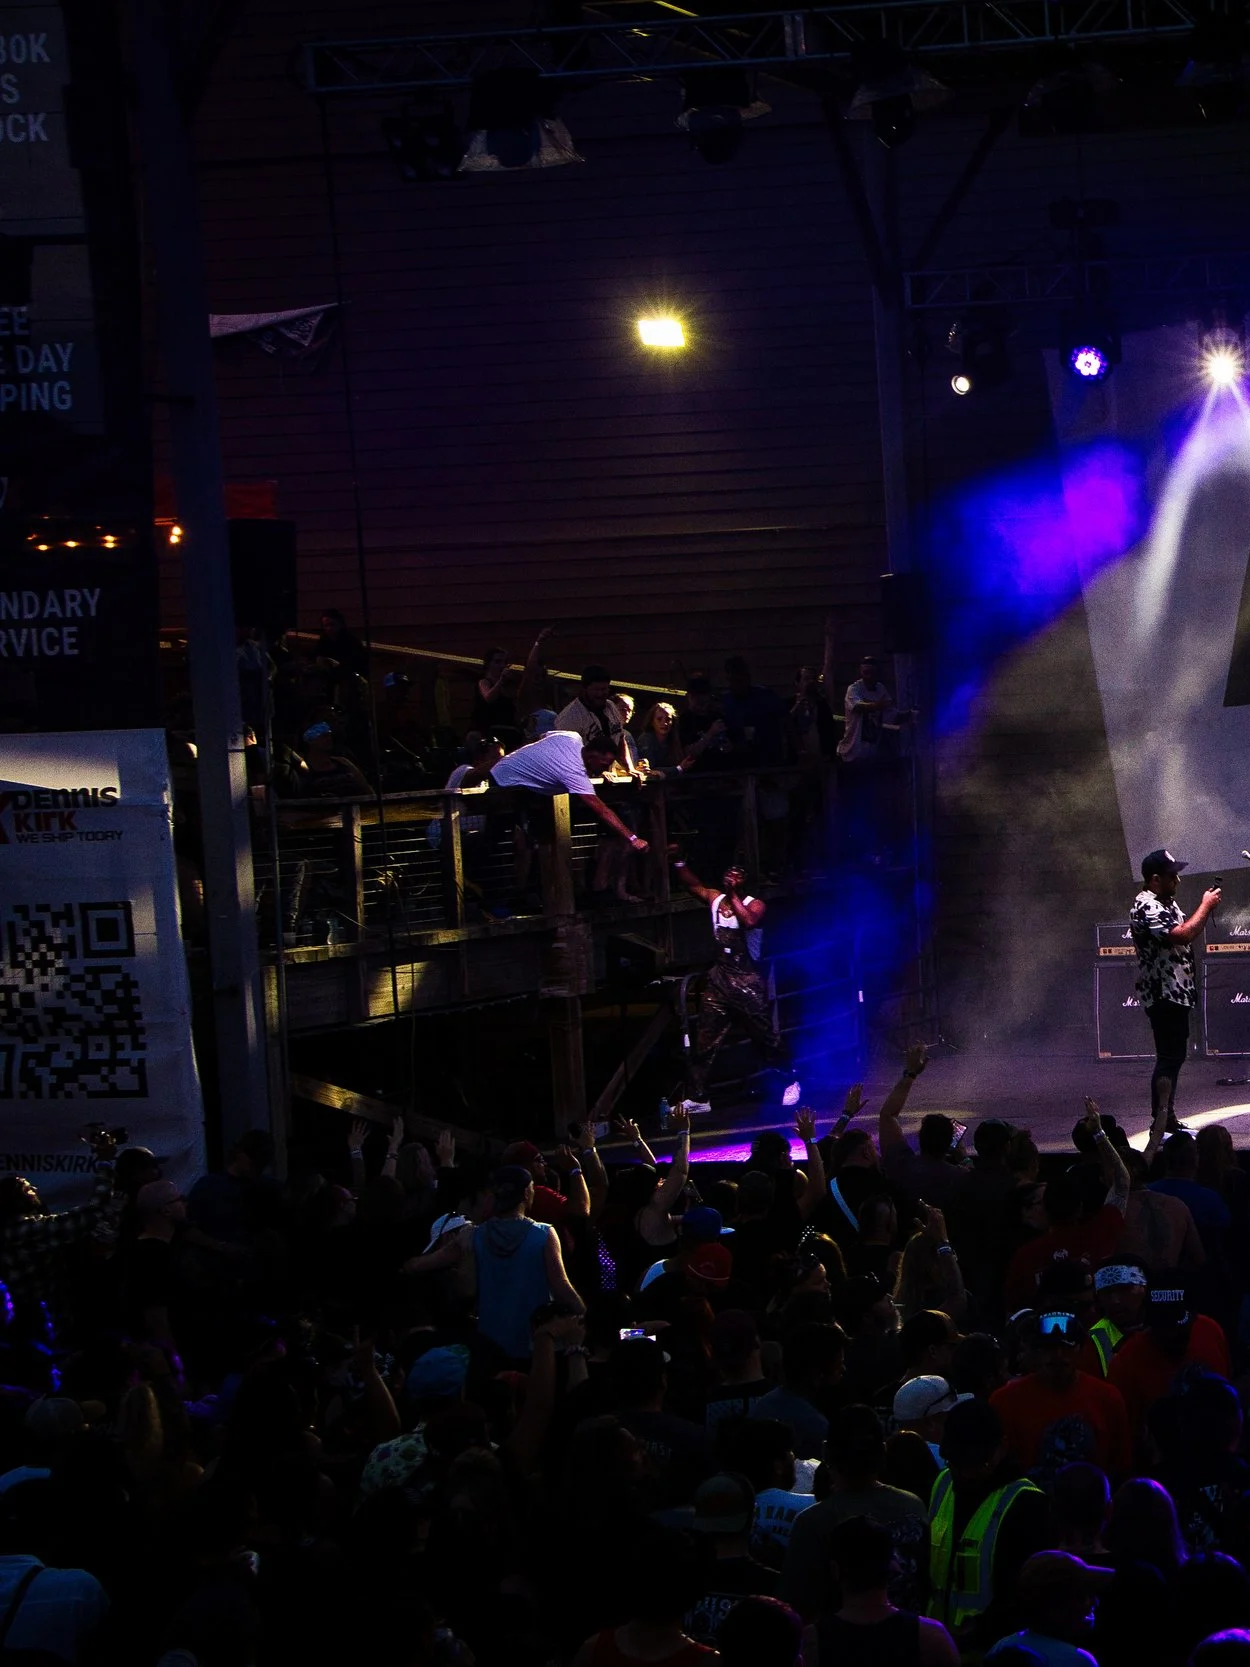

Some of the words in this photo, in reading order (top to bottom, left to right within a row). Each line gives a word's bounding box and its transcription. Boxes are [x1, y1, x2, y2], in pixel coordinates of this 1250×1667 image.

[15, 342, 74, 374] DAY
[16, 834, 39, 844] WE
[43, 832, 74, 843] SHIP
[76, 830, 123, 842] TODAY
[1149, 1290, 1184, 1302] SECURITY
